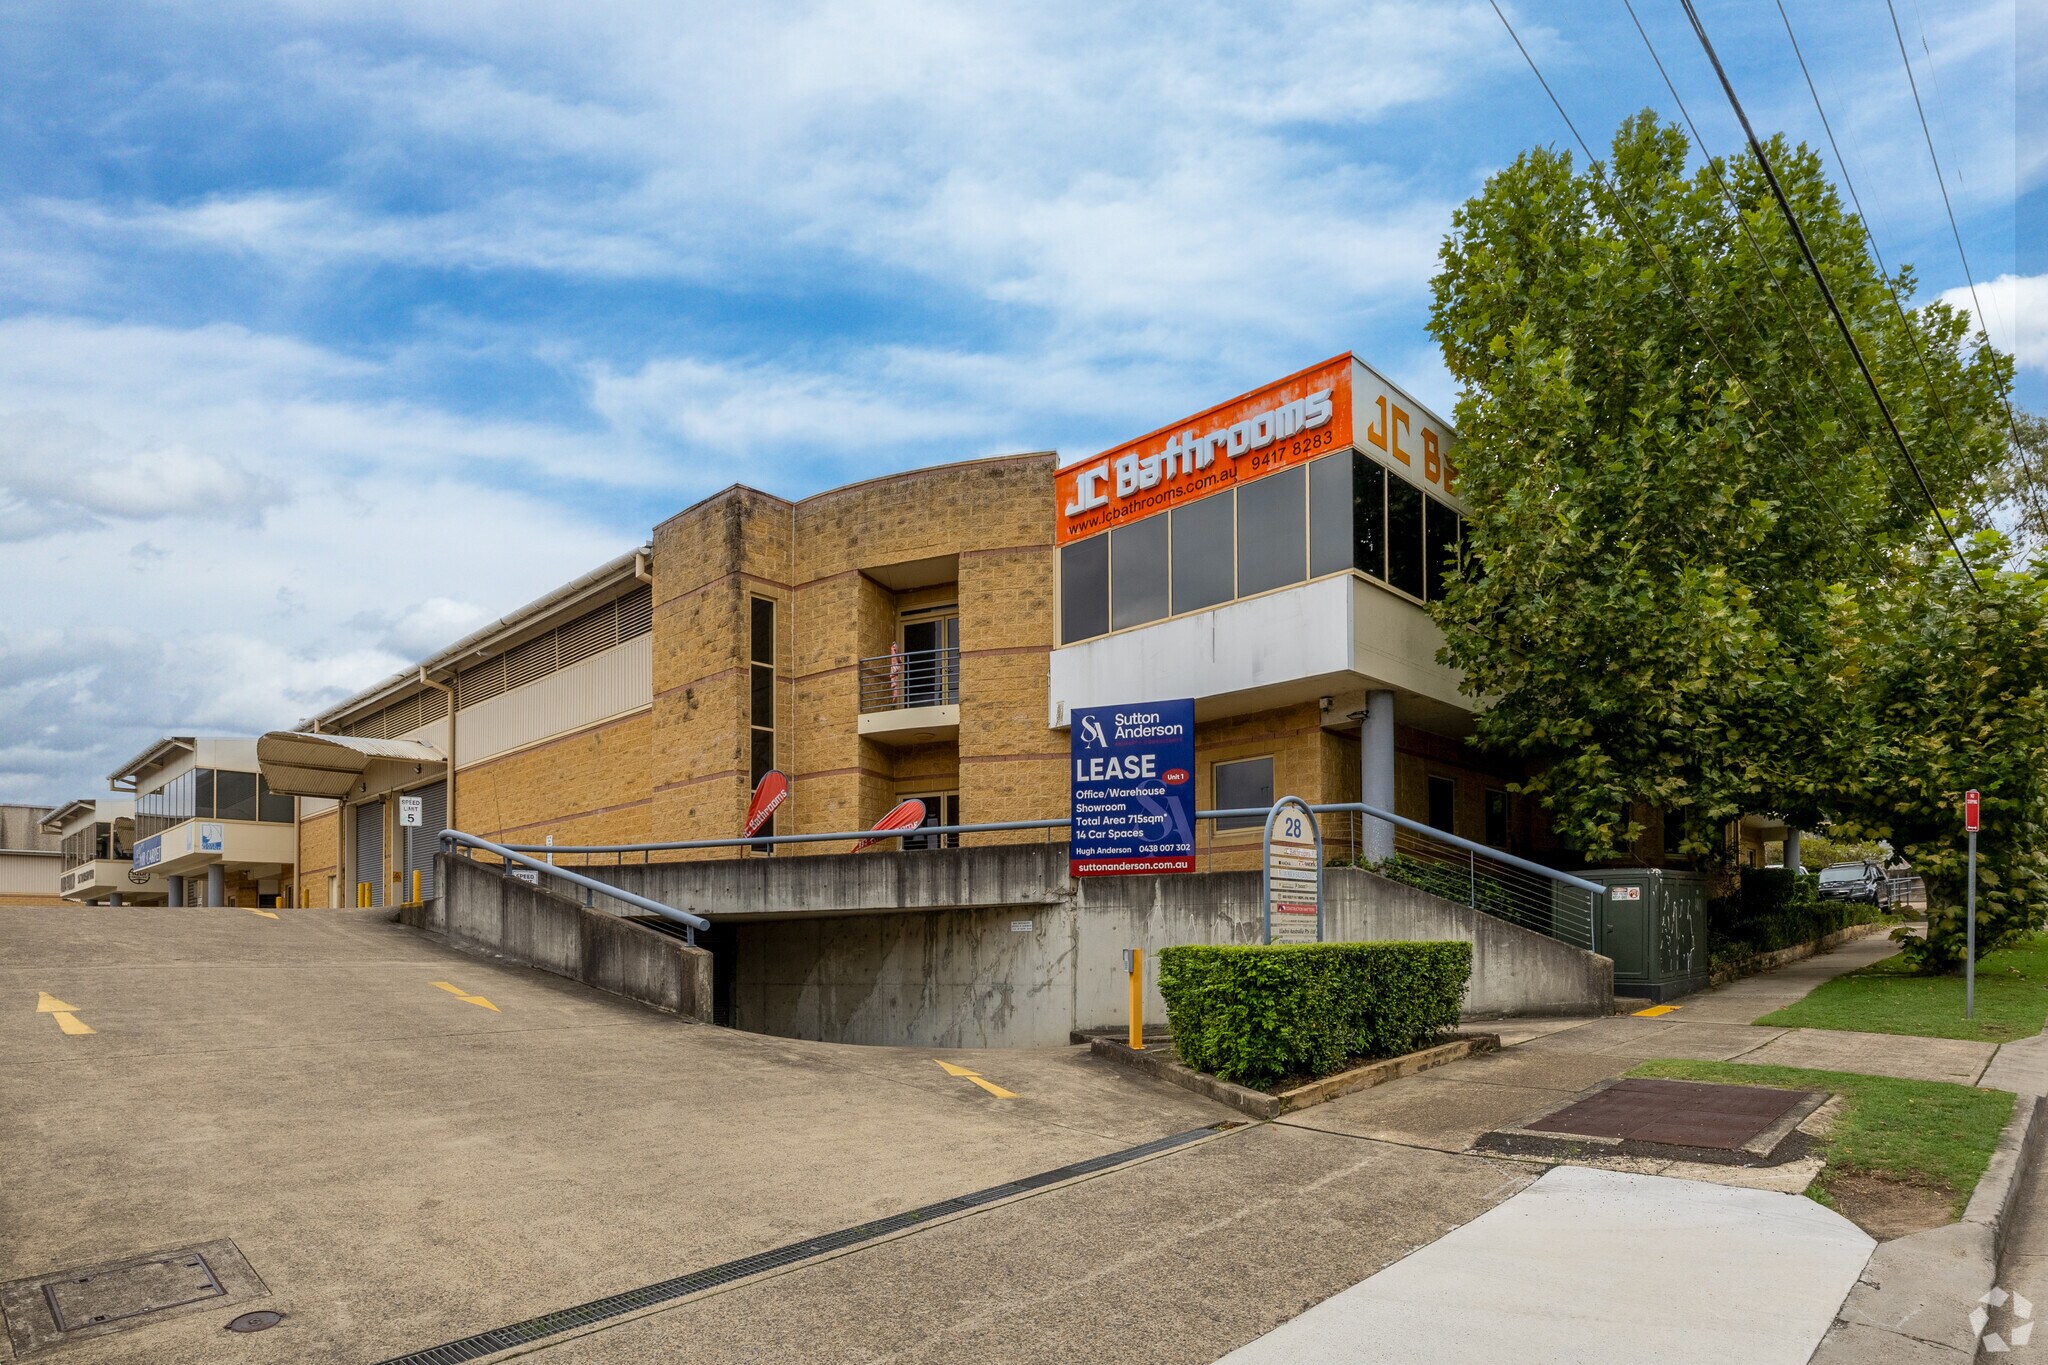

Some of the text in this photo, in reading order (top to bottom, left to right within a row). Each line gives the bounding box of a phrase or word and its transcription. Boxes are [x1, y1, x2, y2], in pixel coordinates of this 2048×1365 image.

[1367, 394, 1410, 468] JC
[1065, 387, 1333, 518] JC Bathrooms
[1251, 446, 1287, 471] 9417
[1292, 430, 1333, 456] 8283
[1114, 712, 1160, 726] Sutton
[1114, 724, 1183, 740] Anderson
[1076, 754, 1156, 782] LEASE
[1075, 787, 1166, 800] Office/Warehouse
[749, 789, 788, 831] Bathrooms
[1075, 803, 1127, 813] Showroom
[407, 813, 415, 823] 5
[1075, 815, 1101, 826] Total
[1102, 815, 1126, 825] Area
[1075, 829, 1144, 840] 14 Car Spaces
[1285, 816, 1302, 839] 28
[1075, 843, 1191, 857] Hugh Anderson 0438 007 302
[1078, 861, 1188, 872] suttonanderson.com.au
